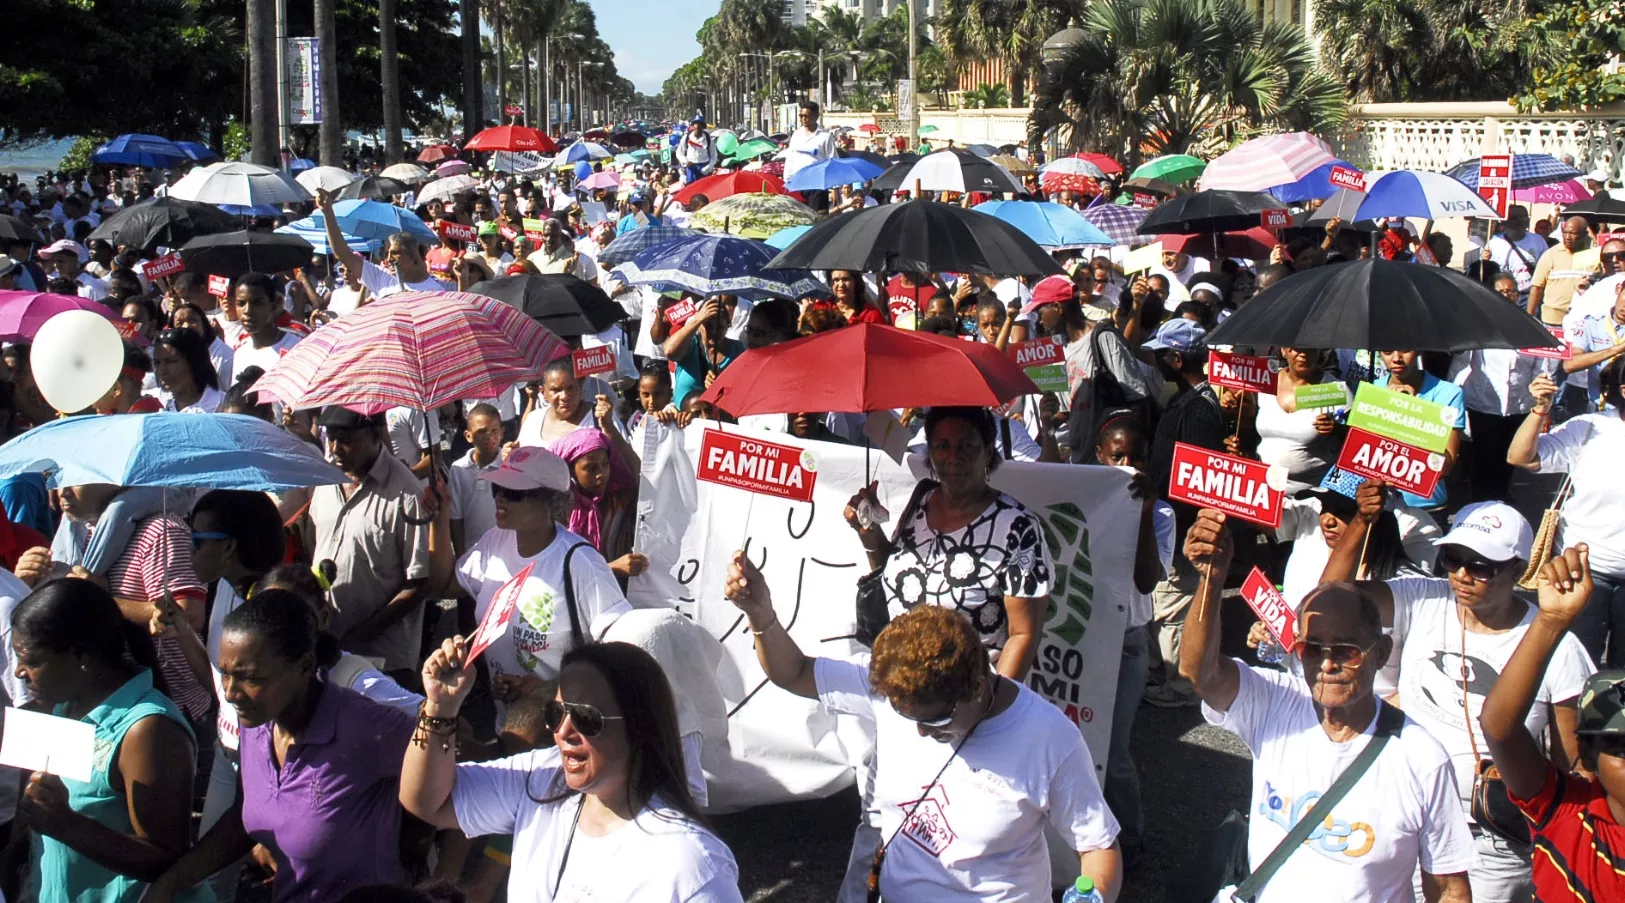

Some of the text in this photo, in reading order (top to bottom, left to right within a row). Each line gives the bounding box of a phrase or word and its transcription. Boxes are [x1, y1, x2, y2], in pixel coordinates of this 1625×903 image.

[1332, 171, 1364, 188] FAMILIA
[1538, 192, 1575, 201] AVON
[1440, 200, 1477, 212] VISA
[1268, 214, 1287, 225] VIDA
[445, 225, 472, 240] AMOR
[147, 259, 182, 277] FAMILIA
[577, 353, 612, 370] FAMILIA
[1016, 344, 1057, 364] AMOR
[1231, 356, 1245, 365] POR
[1213, 361, 1272, 385] FAMILIA
[1389, 396, 1424, 413] POR LA
[1357, 401, 1449, 437] RESPONSABILIDAD
[740, 441, 780, 459] POR MI
[1379, 439, 1410, 456] POR EL
[707, 446, 804, 489] FAMILIA
[1207, 456, 1247, 475] POR MI
[1351, 443, 1427, 485] AMOR
[717, 475, 790, 494] #UNPASOPORMIFAMILIA
[1177, 461, 1270, 510] FAMILIA
[1187, 492, 1257, 517] #UNPASOPORMIFAMILIA
[1267, 588, 1280, 604] POR
[1253, 585, 1287, 637] VIDA
[523, 629, 548, 641] PASO
[1031, 643, 1084, 681] SO
[1030, 672, 1081, 704] MI
